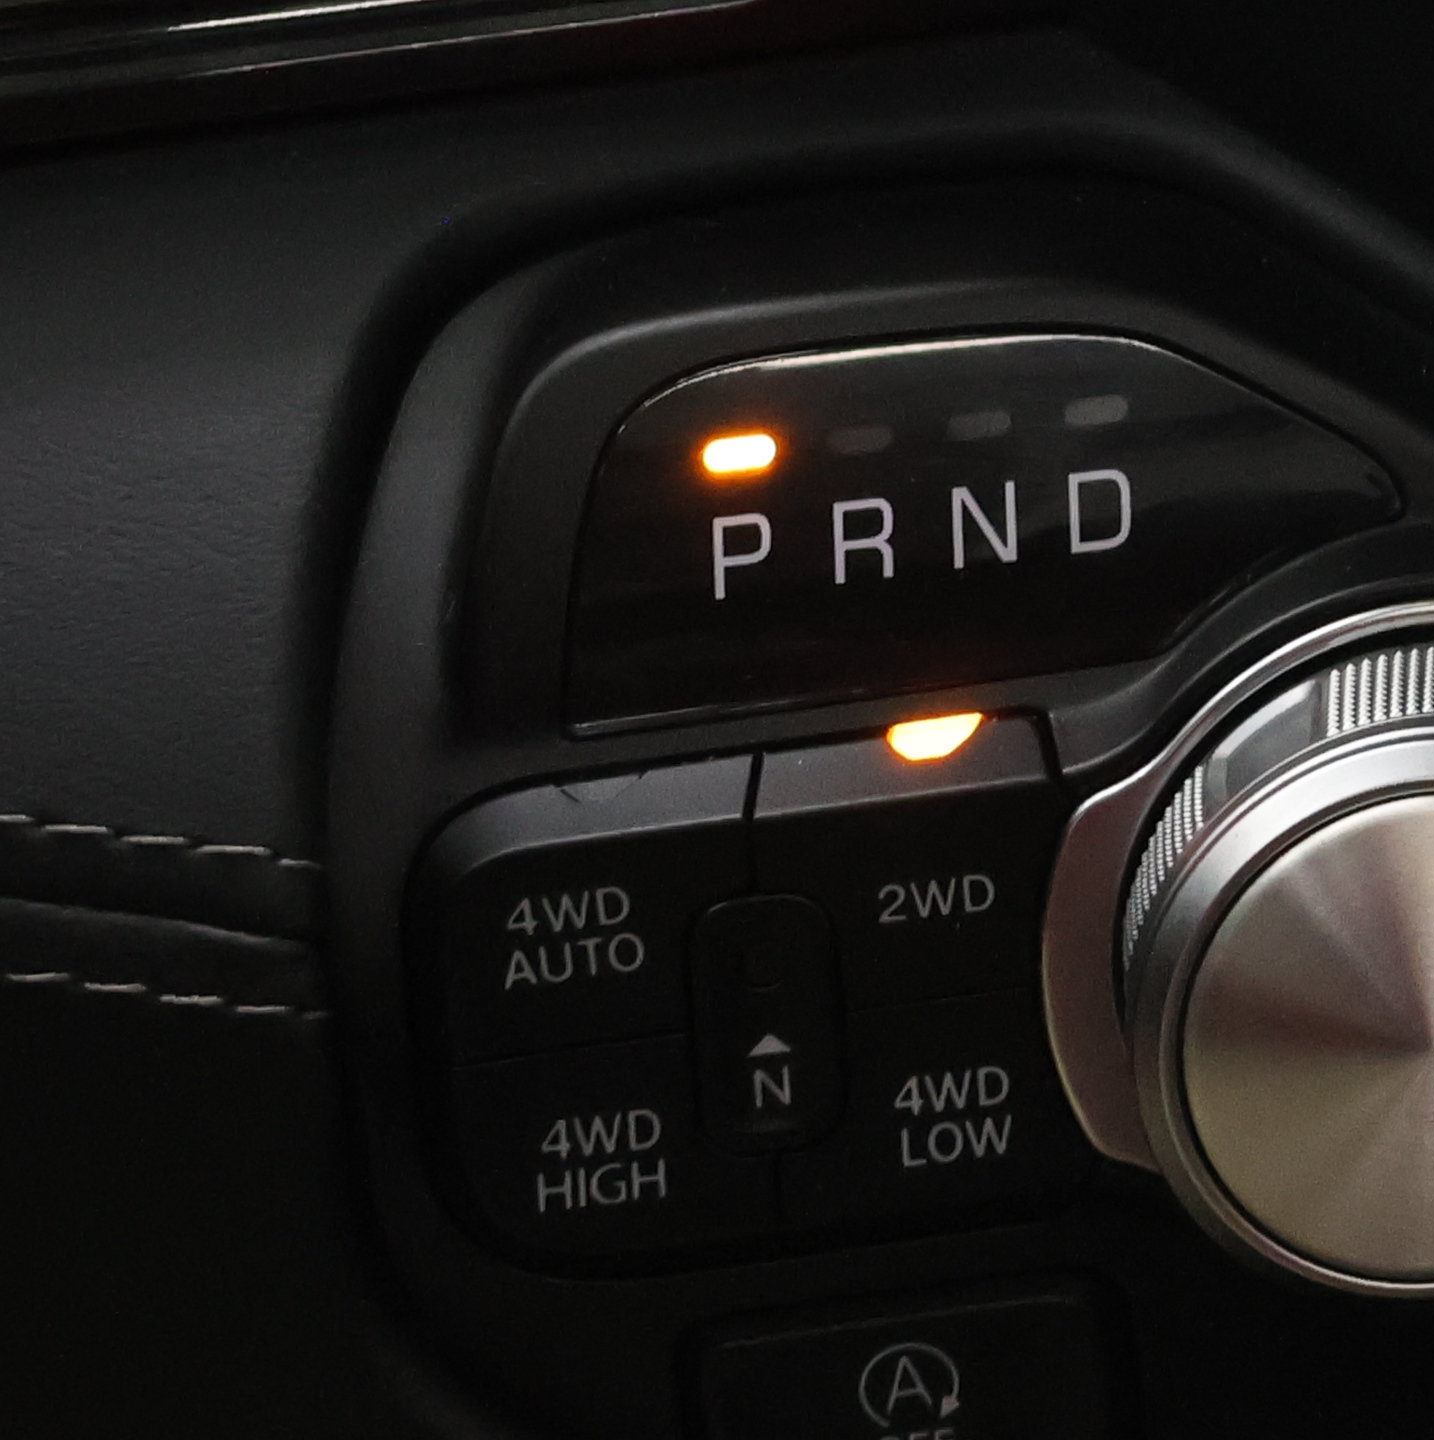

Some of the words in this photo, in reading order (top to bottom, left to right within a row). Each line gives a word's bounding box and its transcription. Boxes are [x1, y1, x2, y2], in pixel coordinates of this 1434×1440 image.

[711, 511, 773, 601] P
[832, 496, 895, 585] R
[950, 479, 1019, 570] N
[1067, 467, 1133, 555] D
[506, 885, 632, 937] 4WD
[877, 873, 996, 923] 2WD
[504, 932, 645, 990] AUTO
[753, 1065, 792, 1108] N
[893, 1065, 1011, 1116] 4WD
[540, 1107, 662, 1160] 4WD
[900, 1114, 1013, 1168] LOW
[536, 1159, 668, 1213] HIGH
[886, 1354, 934, 1415] A
